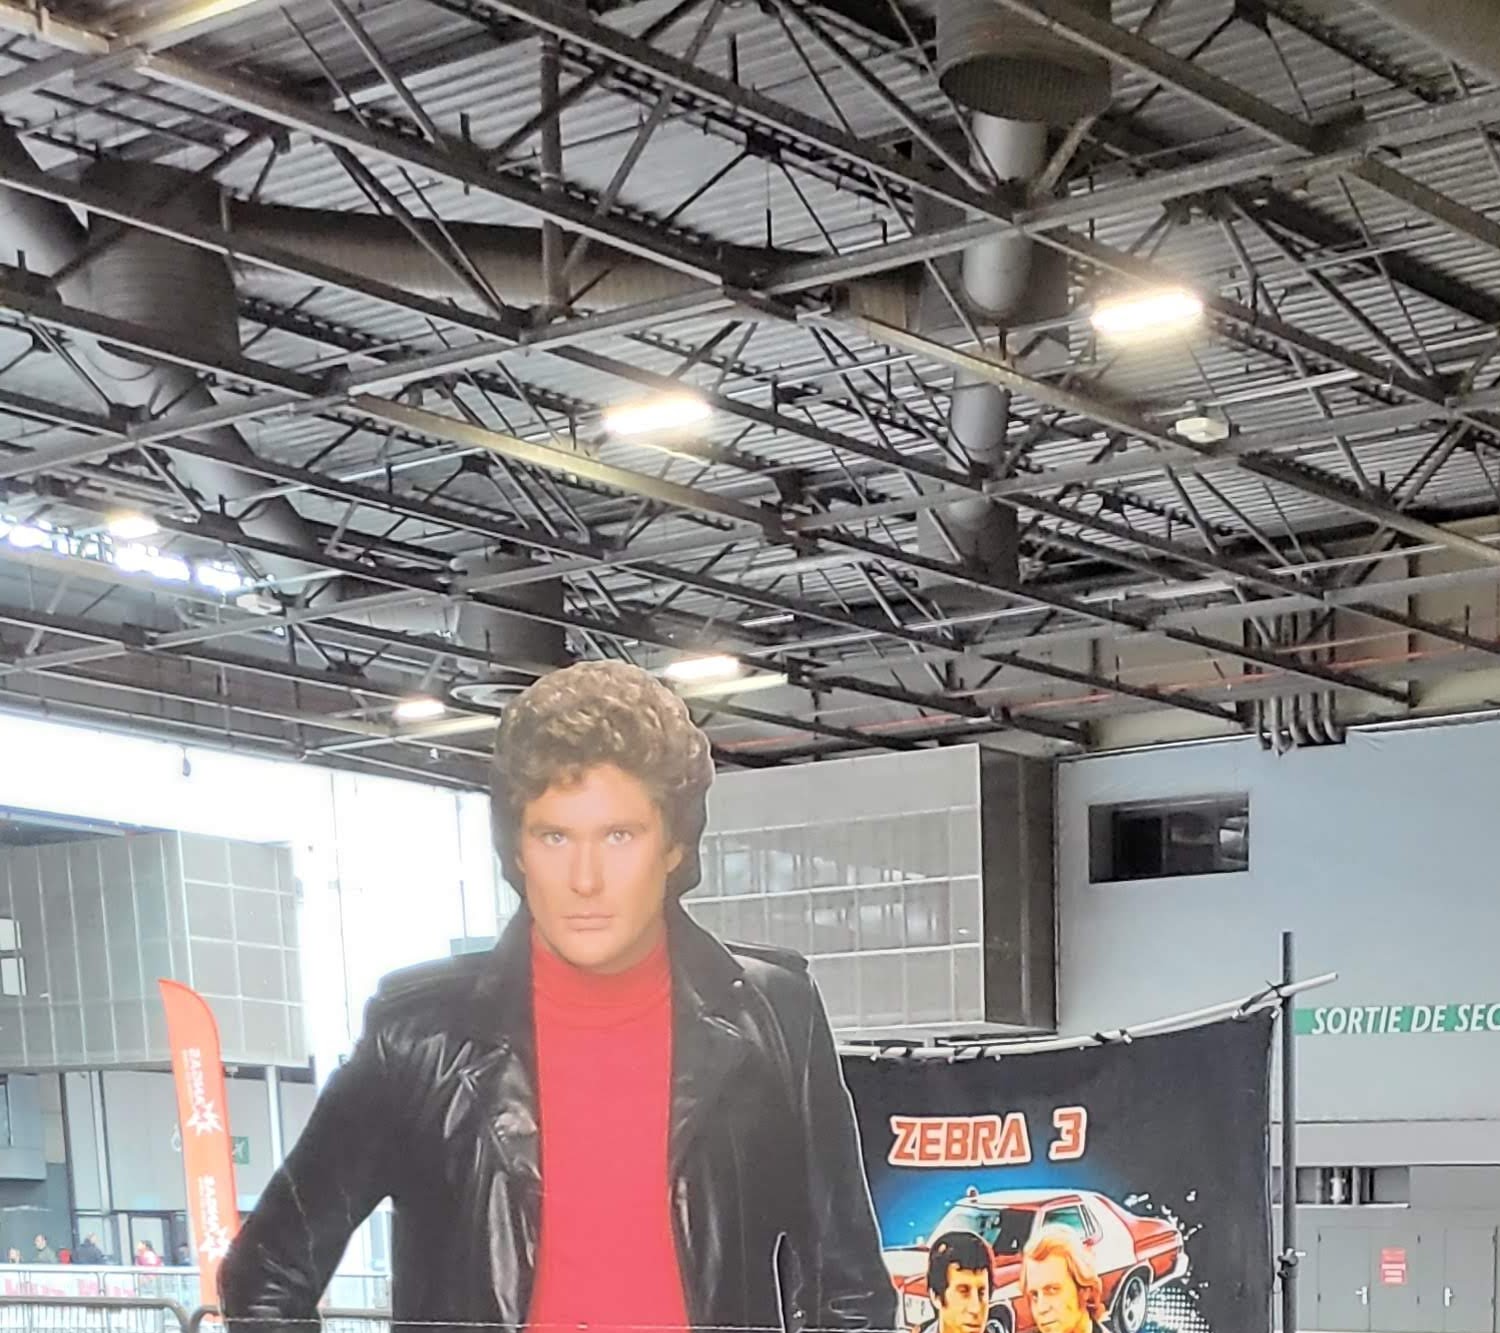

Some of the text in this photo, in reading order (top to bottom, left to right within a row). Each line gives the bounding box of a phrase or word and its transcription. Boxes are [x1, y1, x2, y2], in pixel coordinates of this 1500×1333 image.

[1311, 1005, 1403, 1035] SORTIE
[1410, 1004, 1448, 1033] DE
[890, 1108, 1086, 1164] ZEBRA 3
